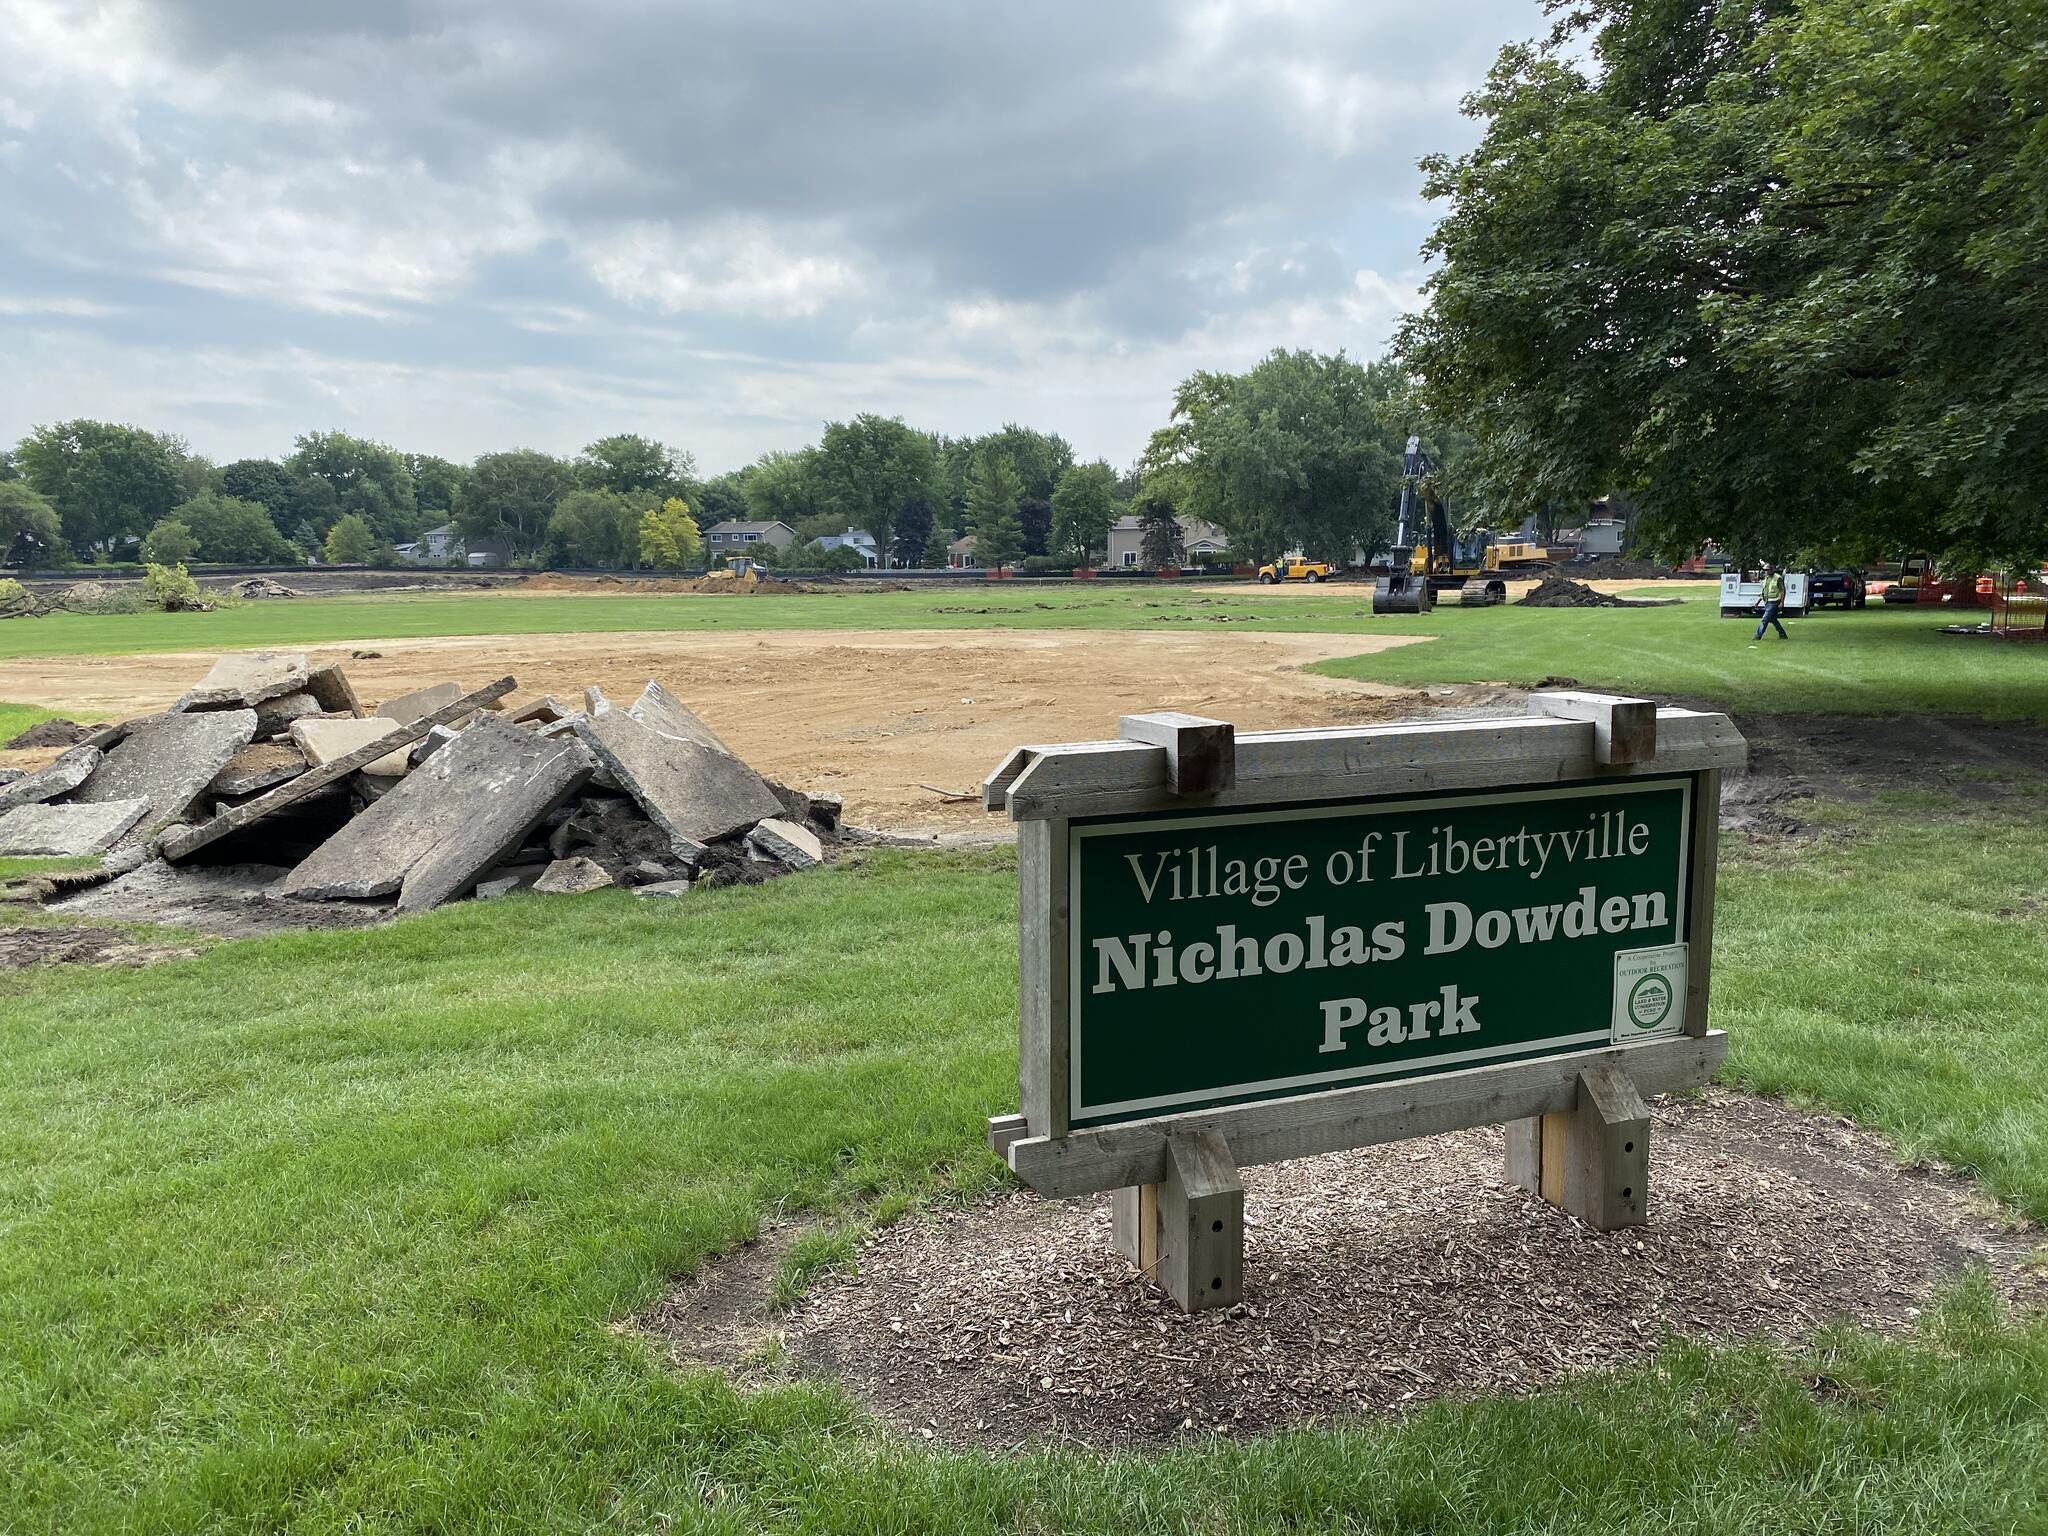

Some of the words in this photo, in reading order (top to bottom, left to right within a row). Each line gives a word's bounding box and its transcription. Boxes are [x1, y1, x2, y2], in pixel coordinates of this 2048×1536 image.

[1124, 845, 1309, 907] Village
[1326, 832, 1382, 886] of
[1390, 810, 1650, 880] Libertyville
[1092, 915, 1406, 994] Nicholas
[1423, 886, 1669, 956] Dowden
[1619, 968, 1648, 977] OUTDOOR
[1649, 962, 1685, 973] RECREATION
[1319, 984, 1481, 1053] Park
